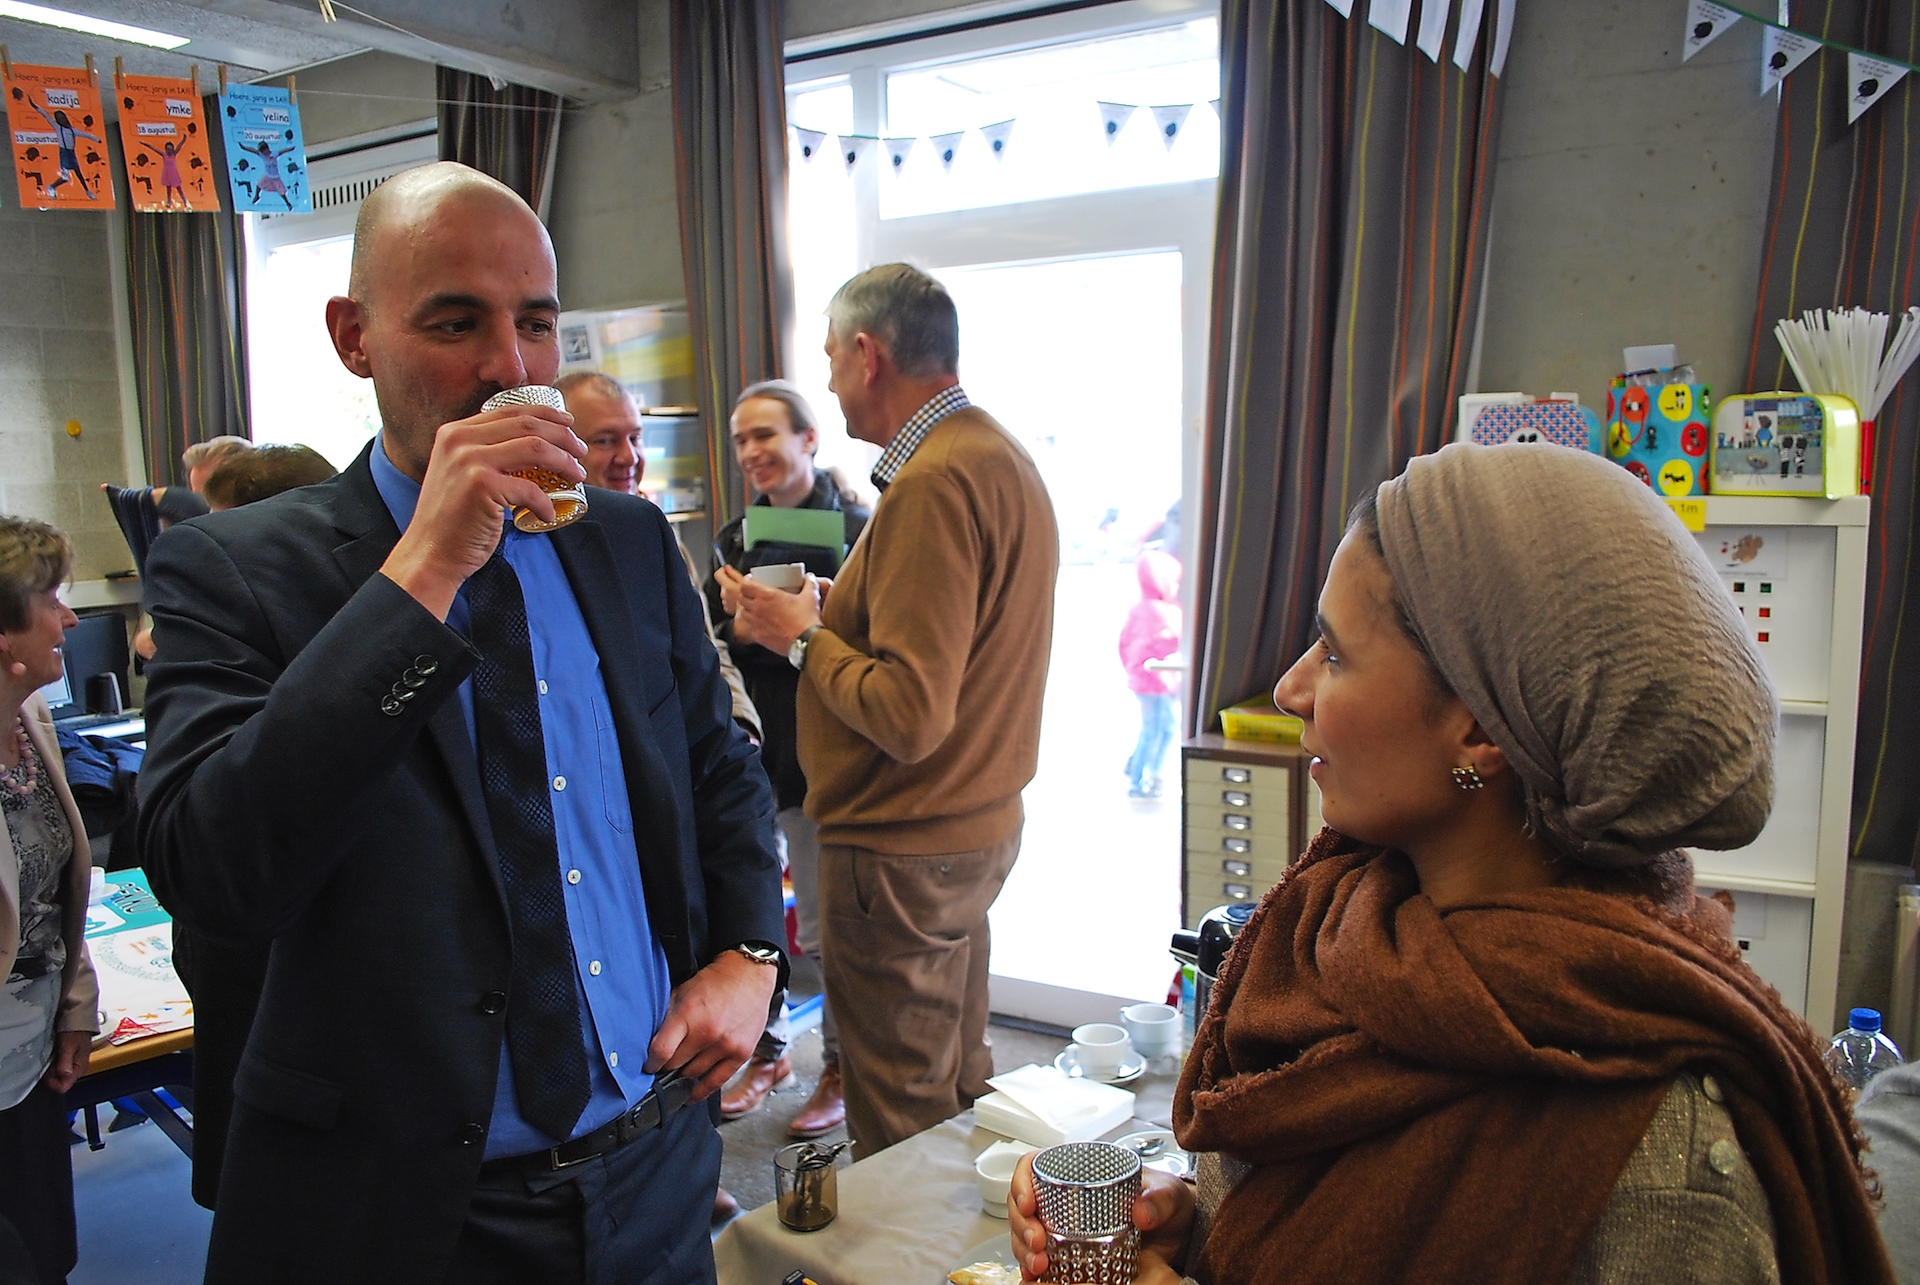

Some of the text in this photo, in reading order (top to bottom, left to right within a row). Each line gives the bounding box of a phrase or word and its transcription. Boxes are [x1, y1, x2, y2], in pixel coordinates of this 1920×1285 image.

[15, 73, 41, 82] Hoera,
[43, 76, 61, 85] jarig
[126, 83, 150, 92] Hoera,
[152, 86, 168, 95] jarig
[47, 93, 80, 108] kadija
[252, 95, 267, 104] jarig
[166, 105, 192, 116] ymke
[263, 113, 289, 122] yelina
[147, 127, 176, 135] augustus
[26, 136, 59, 144] augustus
